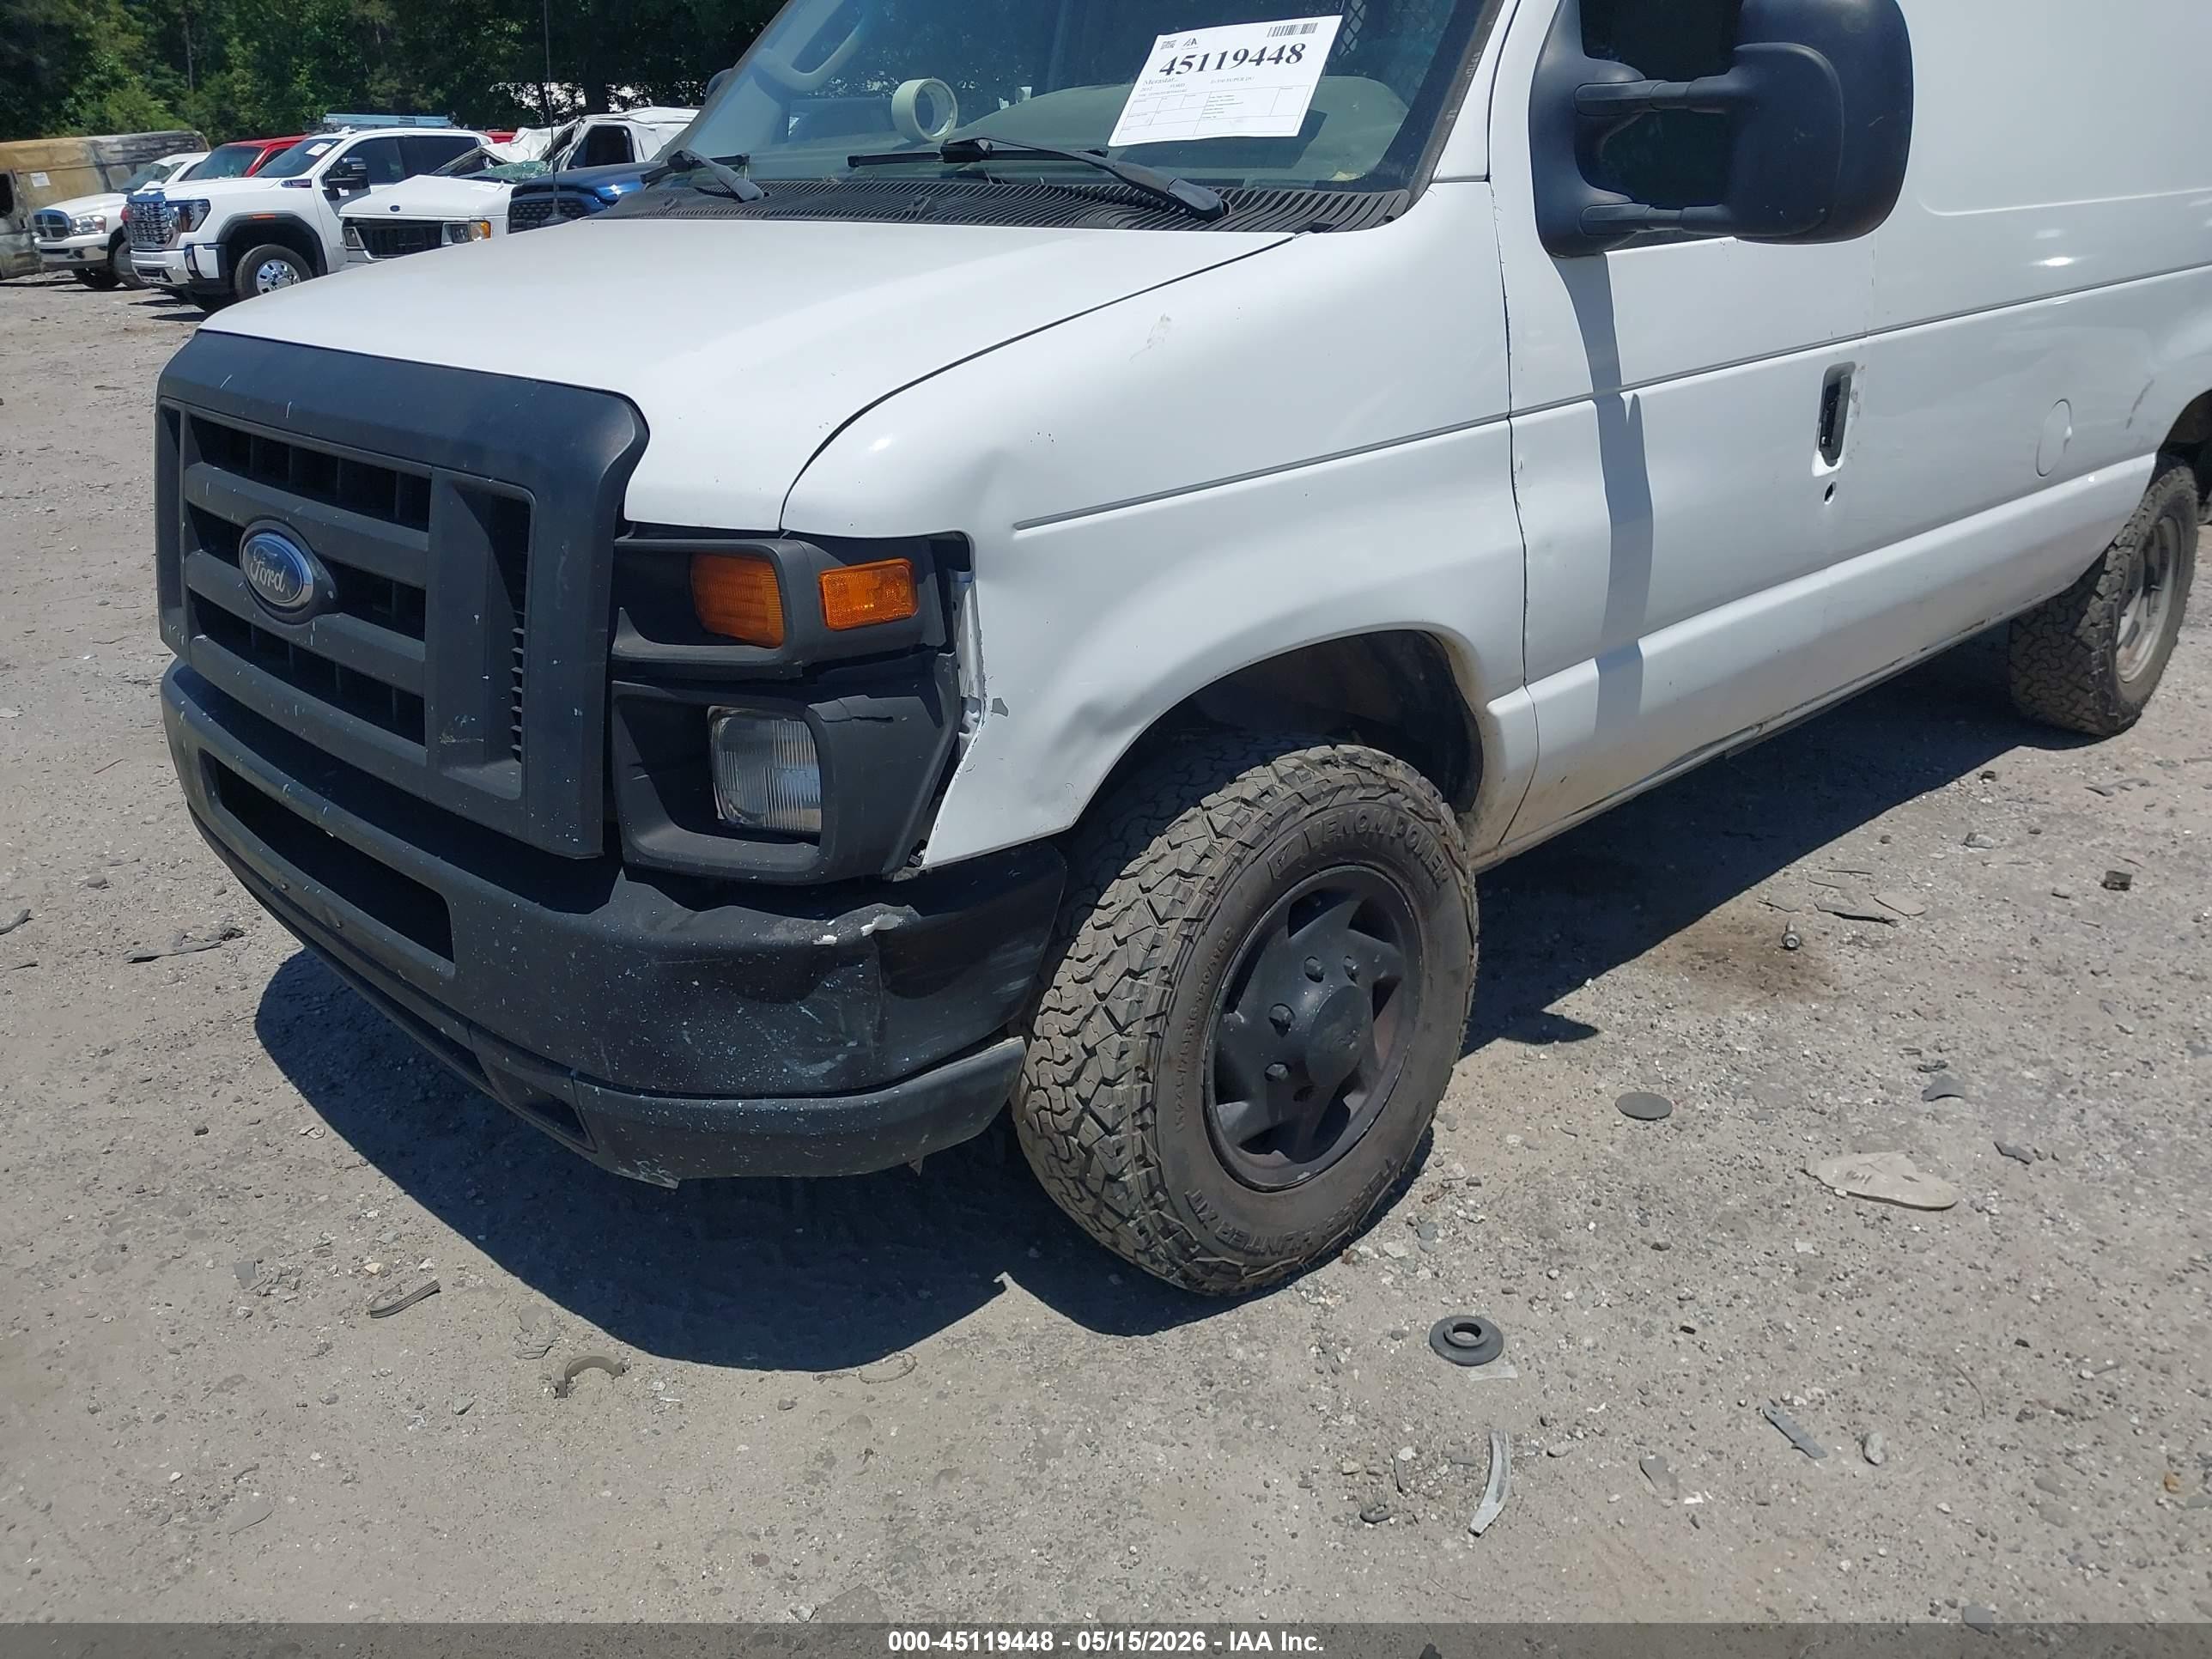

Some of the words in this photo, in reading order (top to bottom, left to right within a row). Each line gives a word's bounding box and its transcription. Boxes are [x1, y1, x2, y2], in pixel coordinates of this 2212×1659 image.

[1159, 43, 1306, 76] 45119448
[250, 545, 285, 592] Ford
[1304, 807, 1389, 850] VENOM
[1390, 816, 1449, 890] POWER
